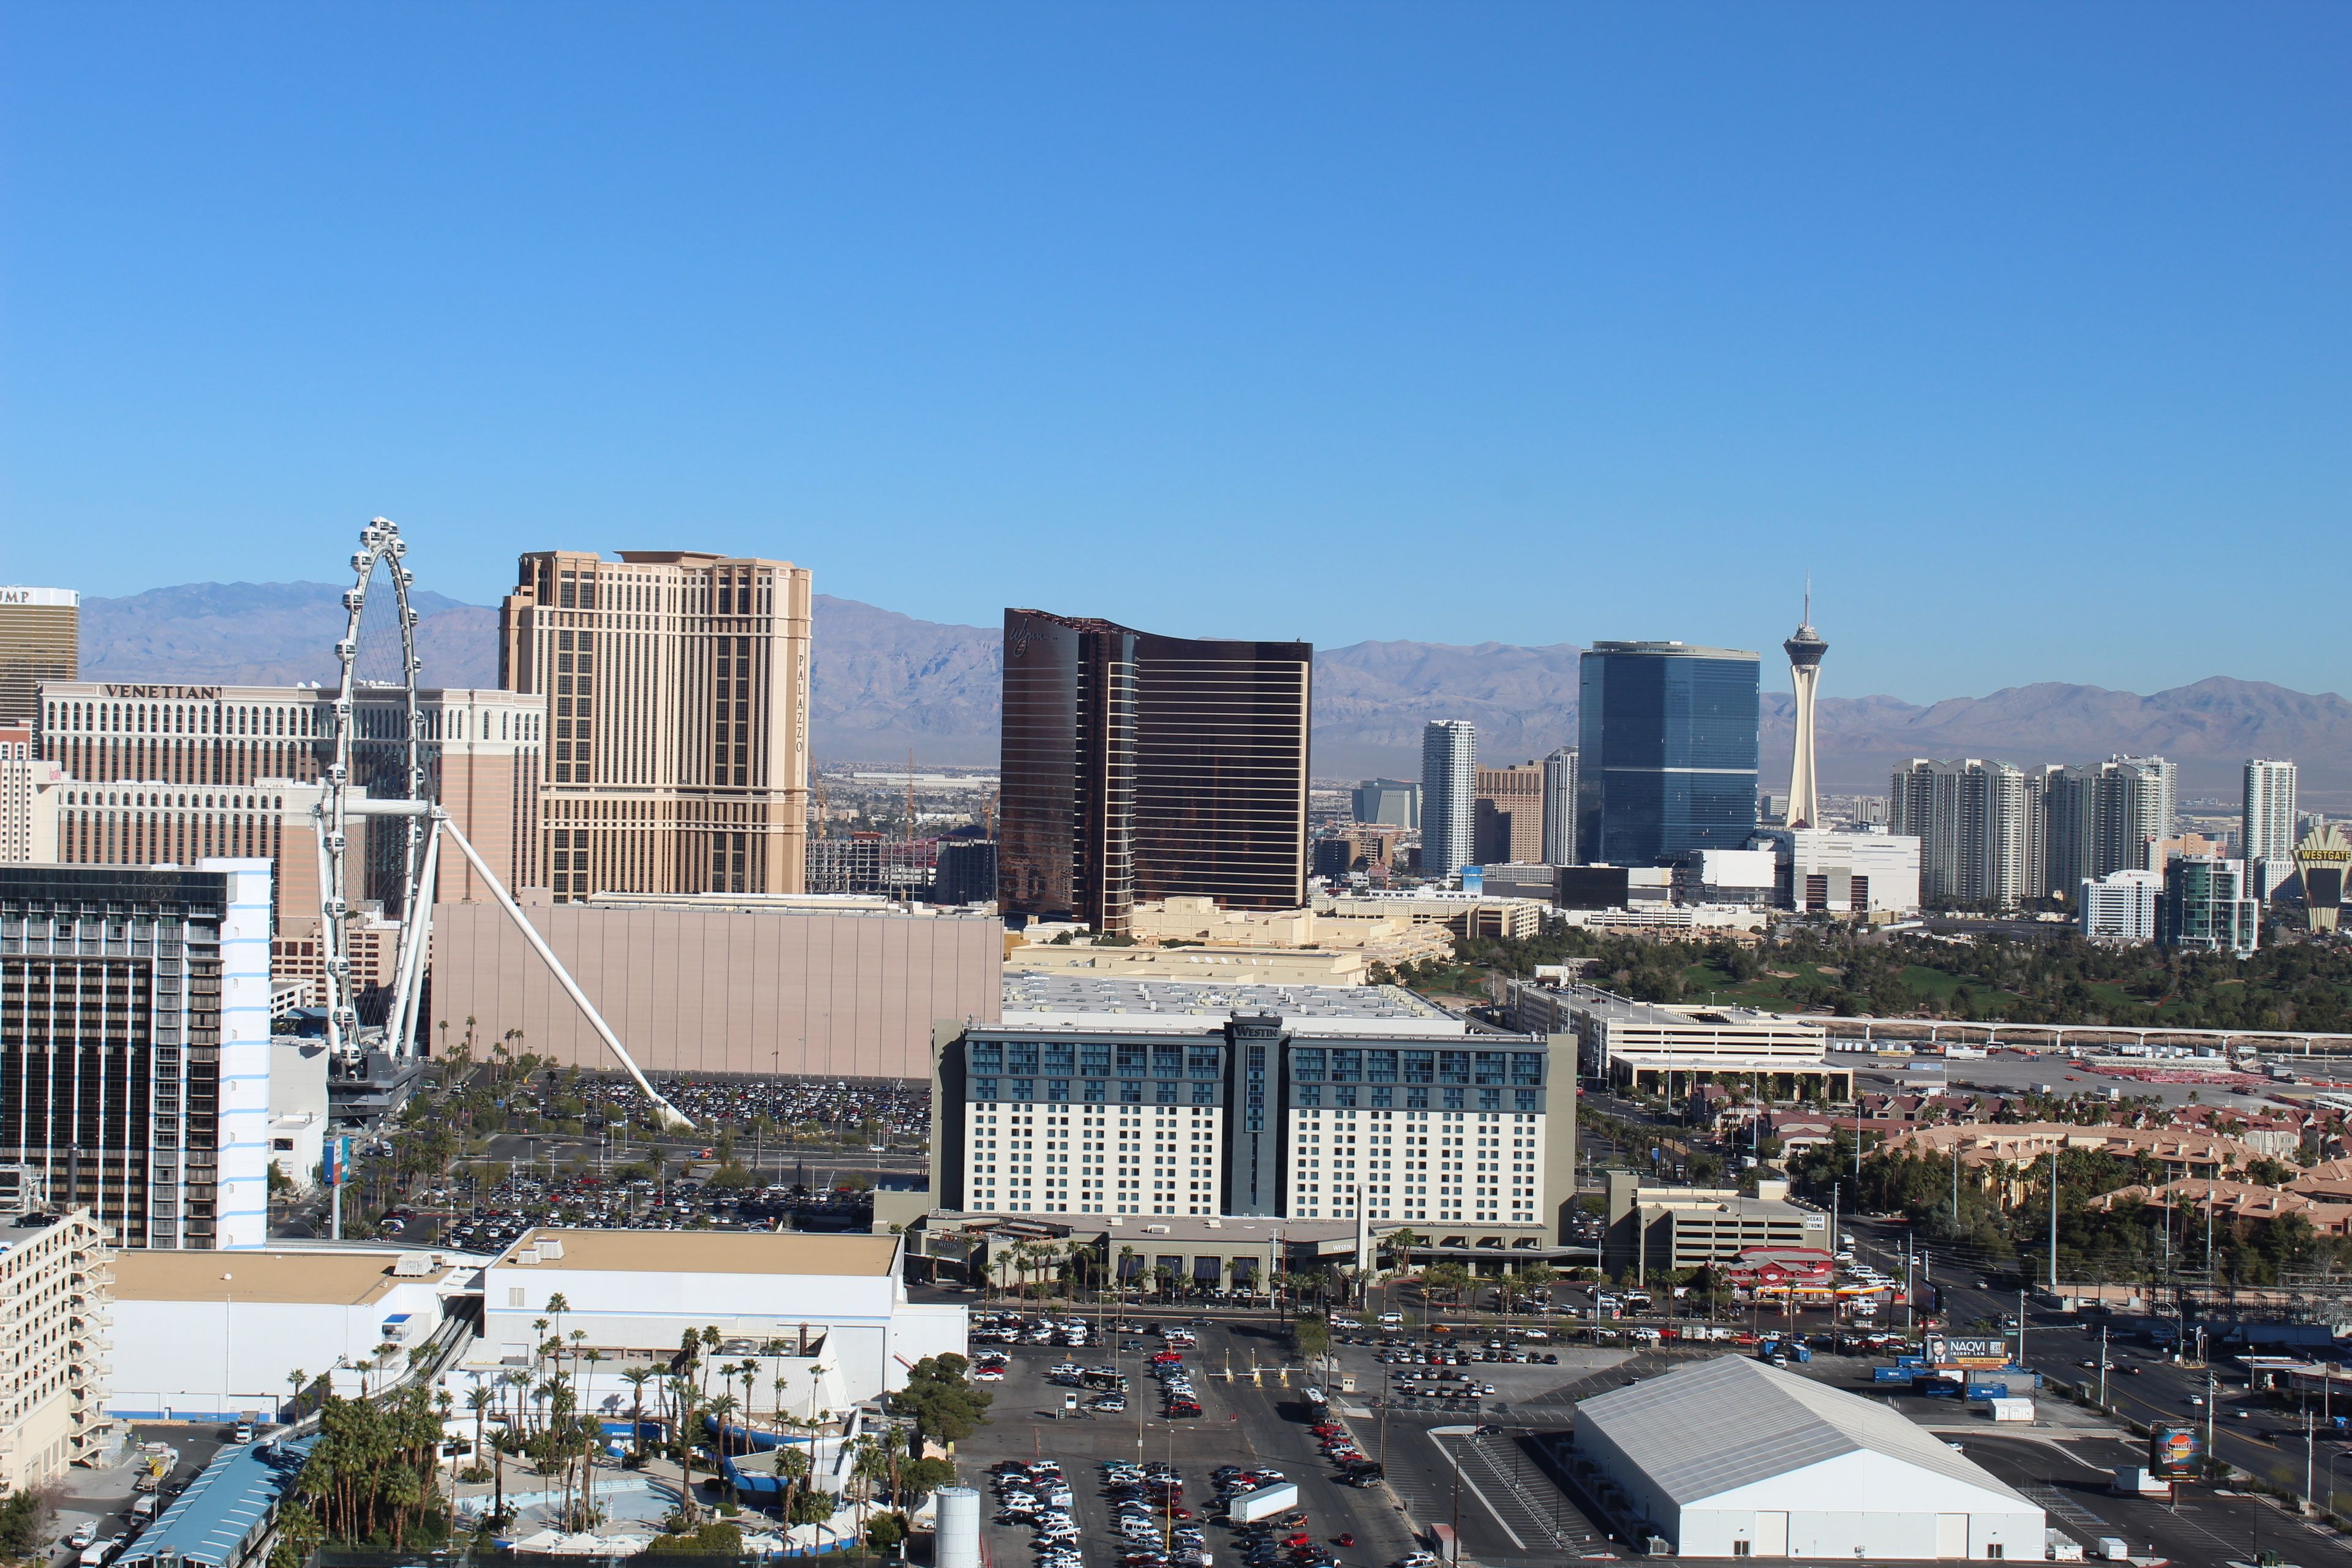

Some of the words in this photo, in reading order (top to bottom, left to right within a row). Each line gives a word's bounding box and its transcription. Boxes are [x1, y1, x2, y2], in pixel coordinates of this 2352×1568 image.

[105, 684, 214, 699] VENETIAN
[2302, 850, 2351, 861] WESTGATE
[1235, 1026, 1278, 1038] WESTIN
[938, 1240, 959, 1250] WESTIN
[1950, 1341, 1985, 1352] NAQVI
